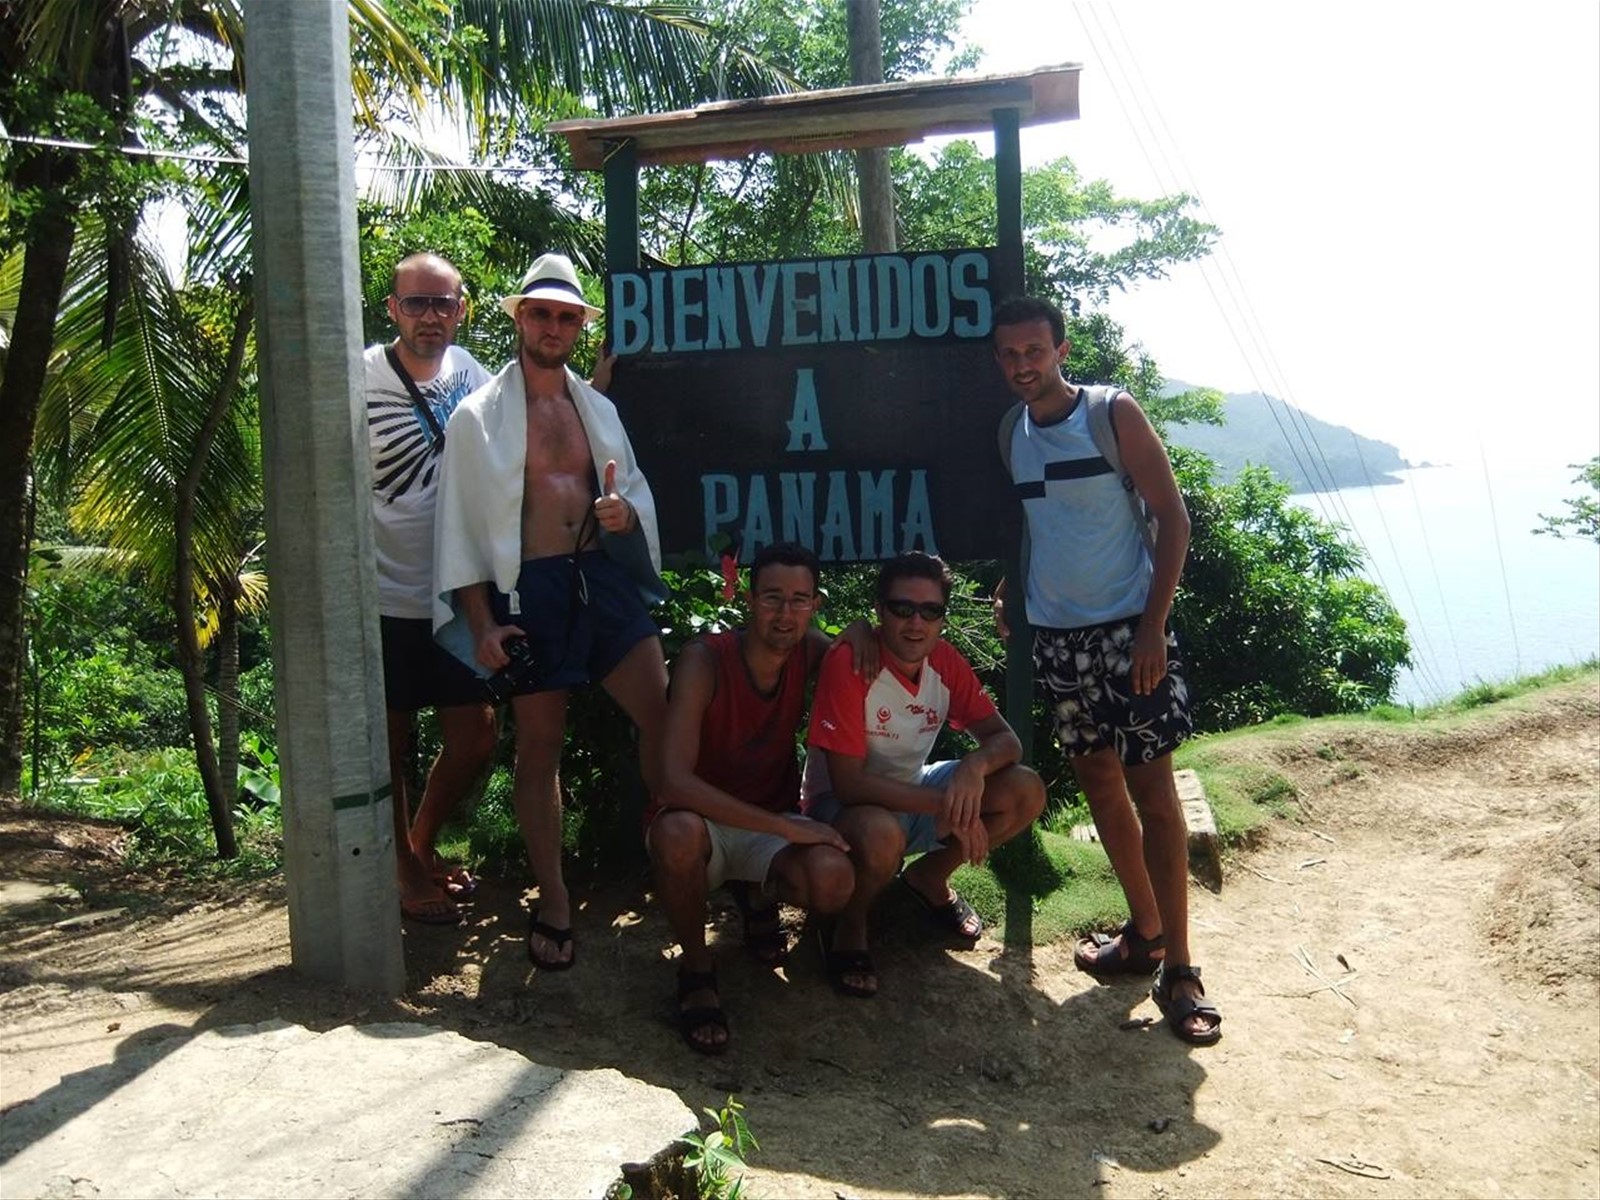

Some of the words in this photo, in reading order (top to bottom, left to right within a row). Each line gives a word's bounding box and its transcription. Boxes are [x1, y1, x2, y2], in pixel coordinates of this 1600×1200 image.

[611, 253, 993, 356] BIENVENIDOS
[785, 368, 828, 452] A
[701, 469, 940, 563] PANAMA
